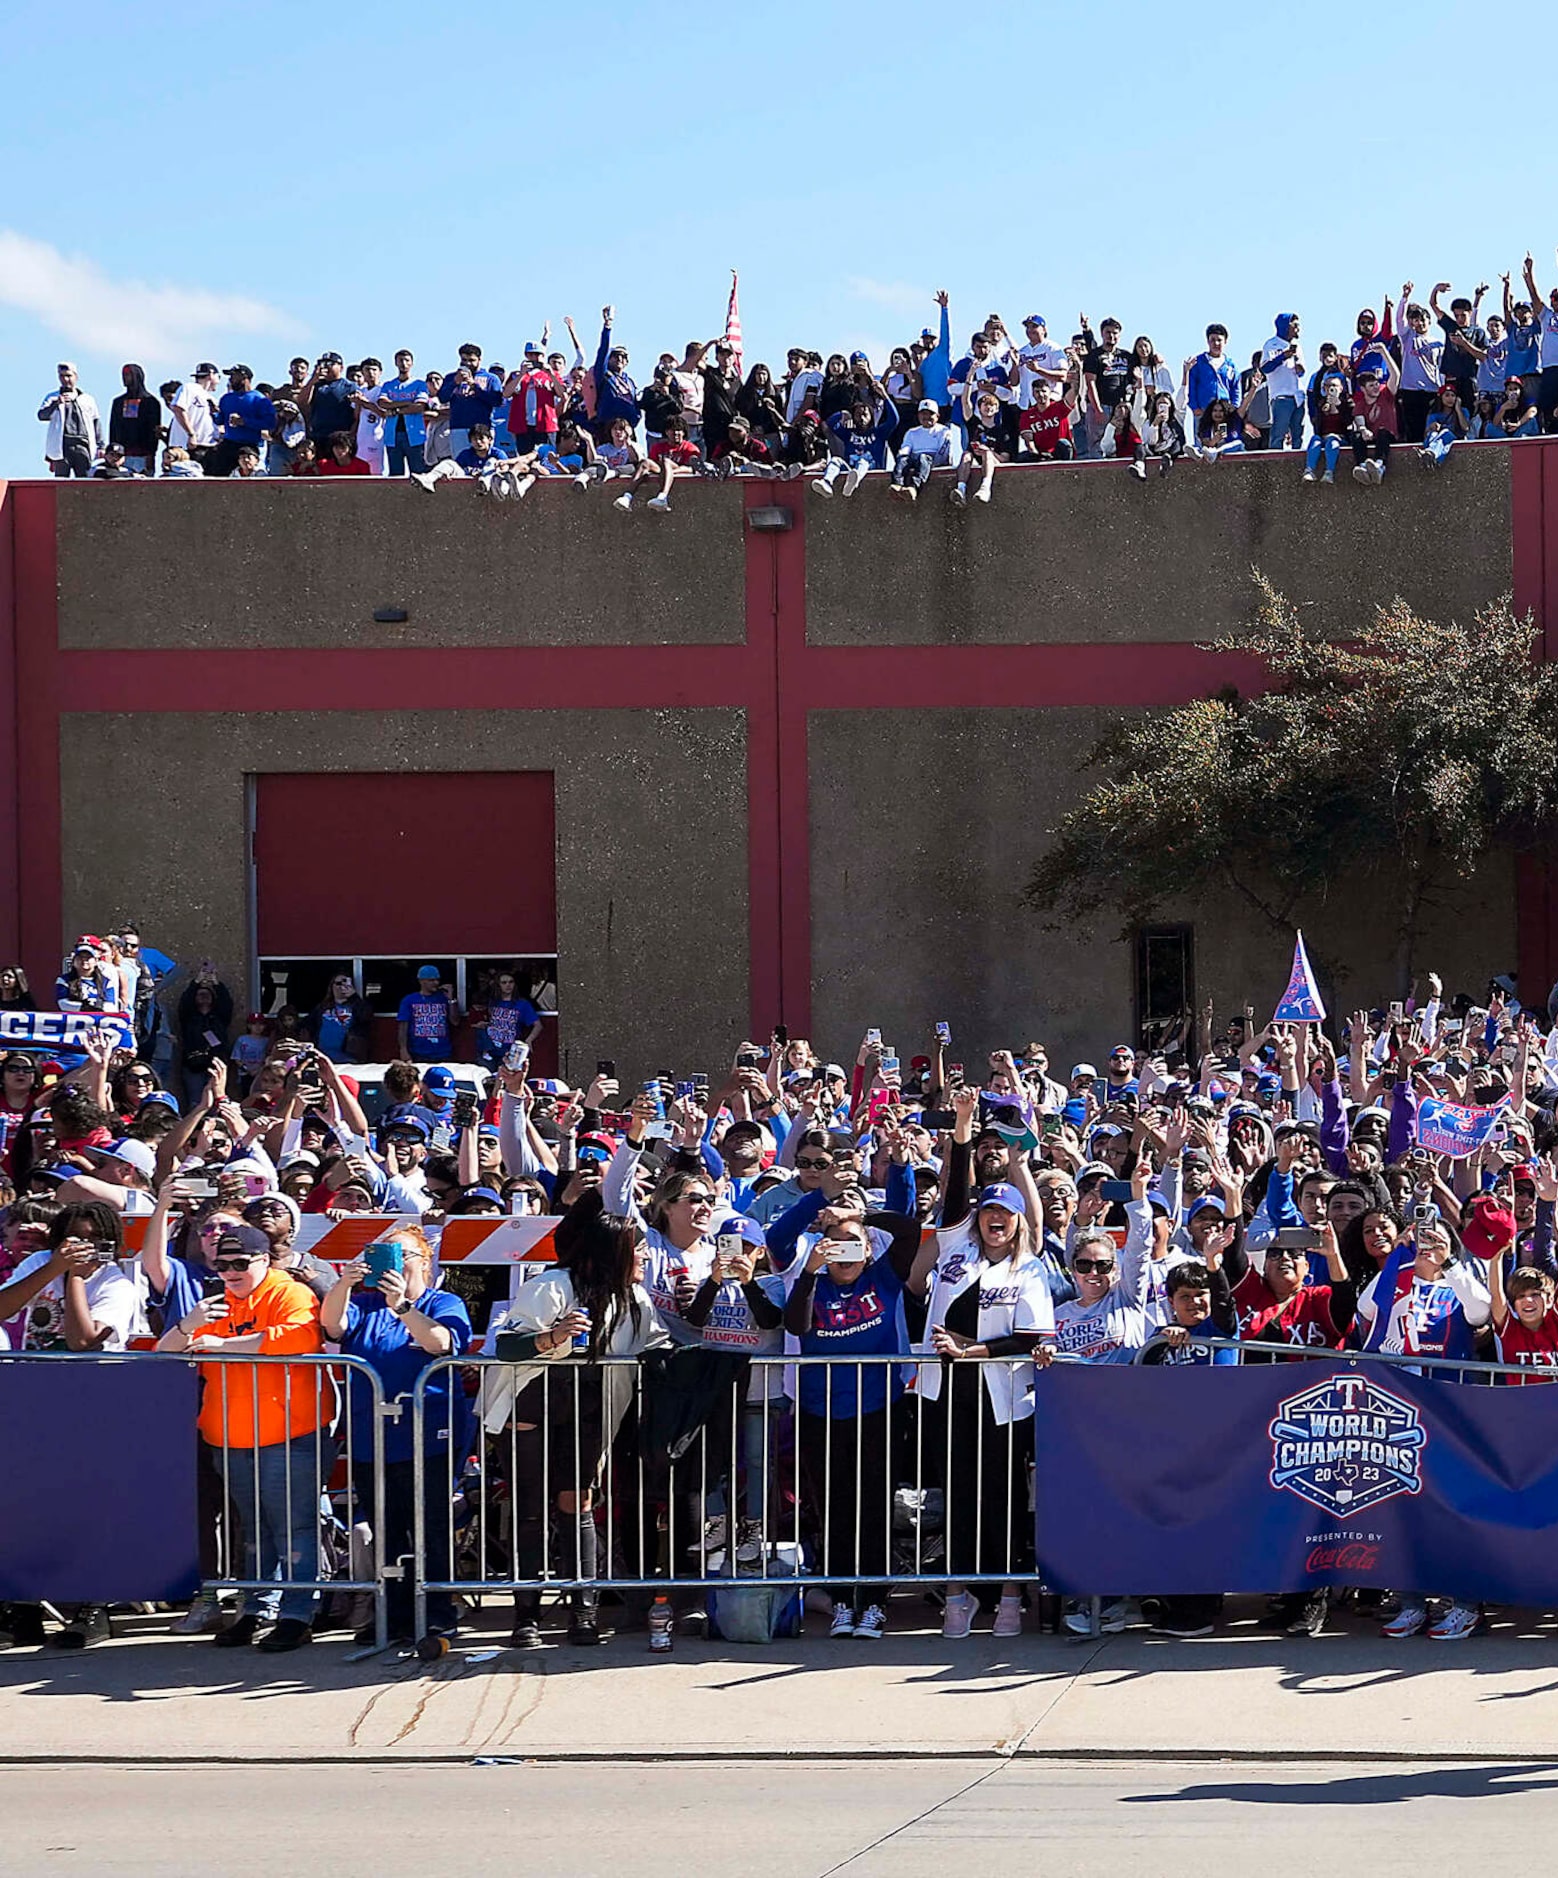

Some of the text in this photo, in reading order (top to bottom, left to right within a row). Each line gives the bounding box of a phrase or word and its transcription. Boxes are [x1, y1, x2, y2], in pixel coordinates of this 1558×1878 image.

[1031, 416, 1060, 433] TEXAS
[993, 1185, 1009, 1198] T
[733, 1219, 748, 1234] T
[860, 1292, 878, 1312] T
[818, 1317, 884, 1337] CHAMPIONS
[704, 1329, 760, 1346] HAMPIONS
[1336, 1378, 1364, 1412] T
[1310, 1412, 1388, 1439] WORLD
[1281, 1439, 1415, 1476] CHAMPIONS
[1314, 1467, 1380, 1483] 20 23
[1305, 1532, 1383, 1545] PRESENTED BY
[1305, 1543, 1379, 1574] Coca-Cola
